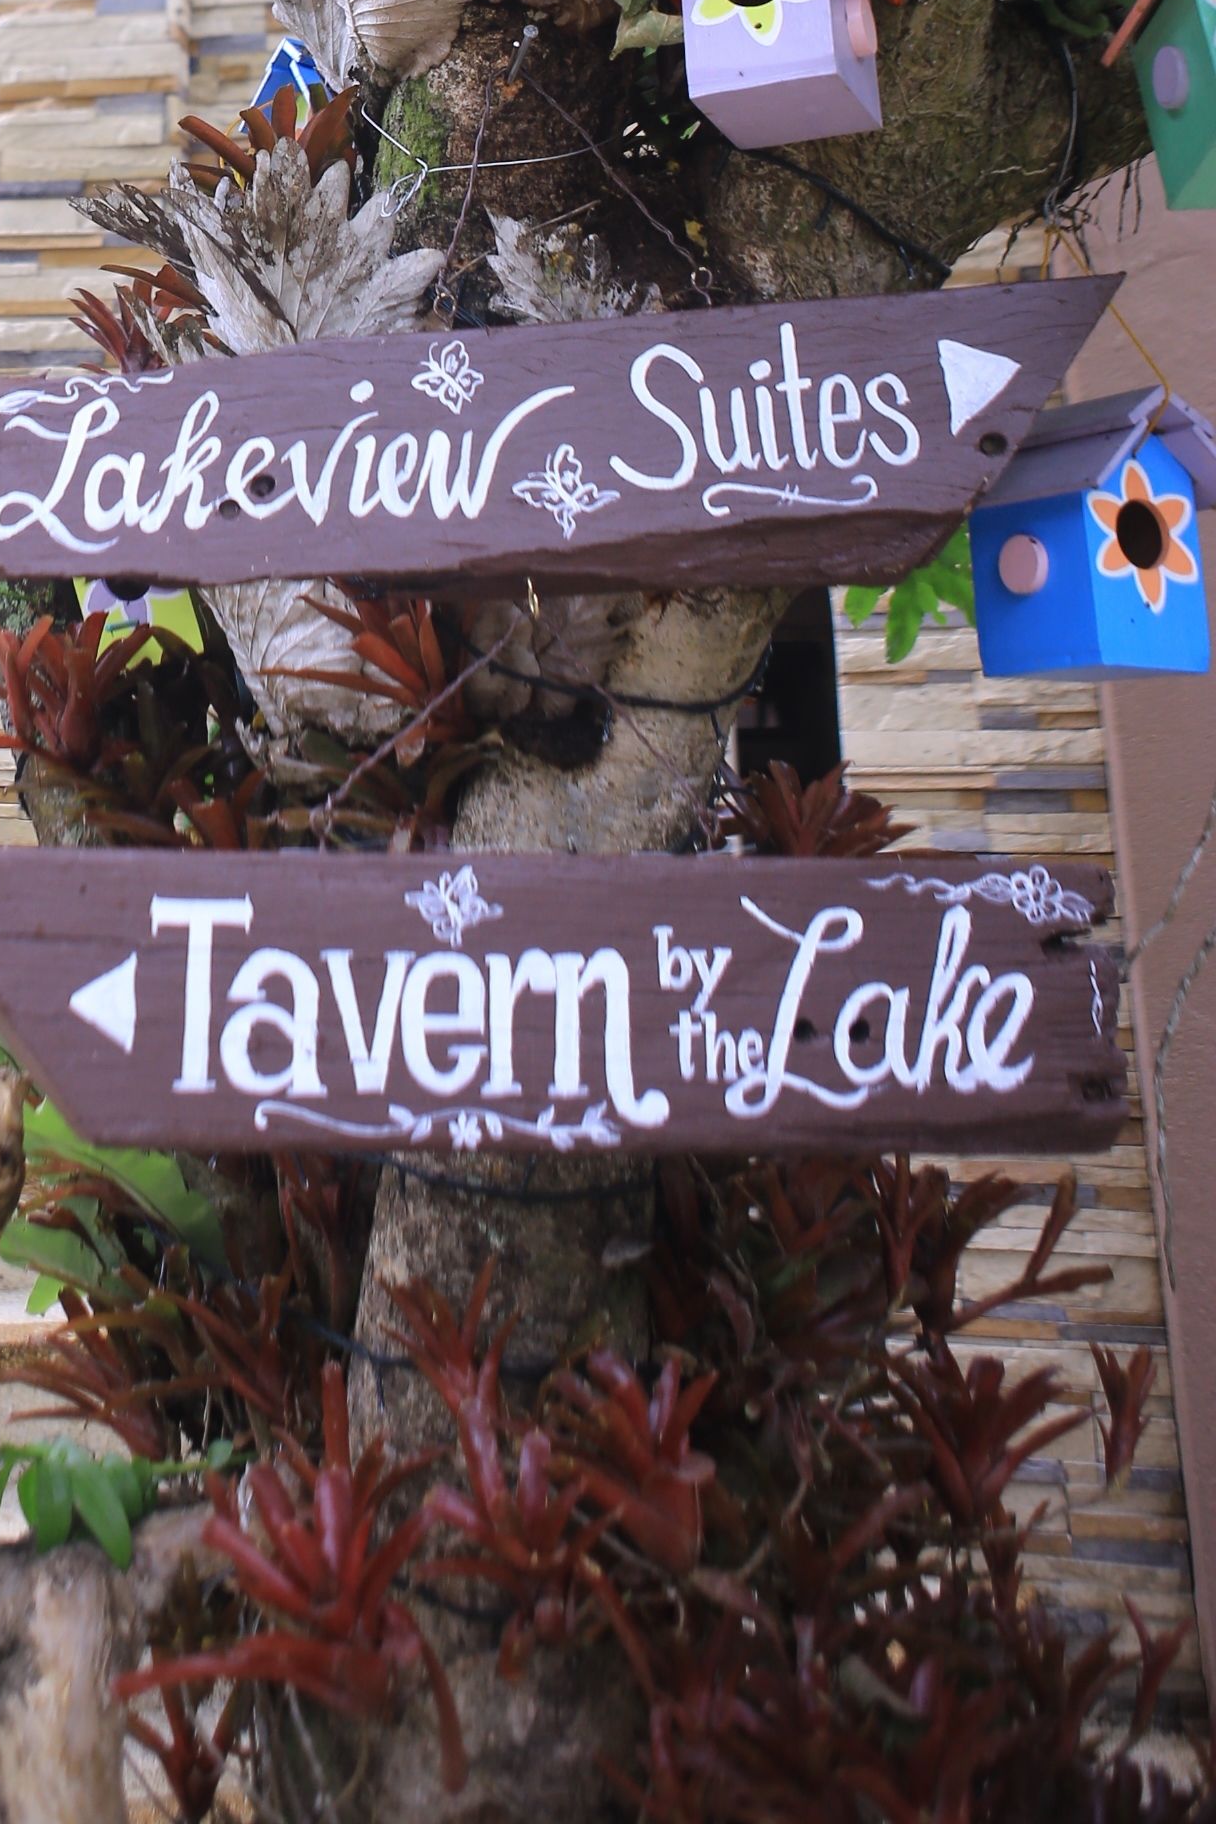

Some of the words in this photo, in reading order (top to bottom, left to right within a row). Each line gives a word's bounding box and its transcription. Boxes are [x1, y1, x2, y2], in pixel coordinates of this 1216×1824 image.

[610, 322, 922, 490] Suites
[149, 893, 670, 1128] Tavern
[653, 925, 733, 1014] by
[669, 1008, 766, 1082] the
[724, 894, 1036, 1118] Lake
